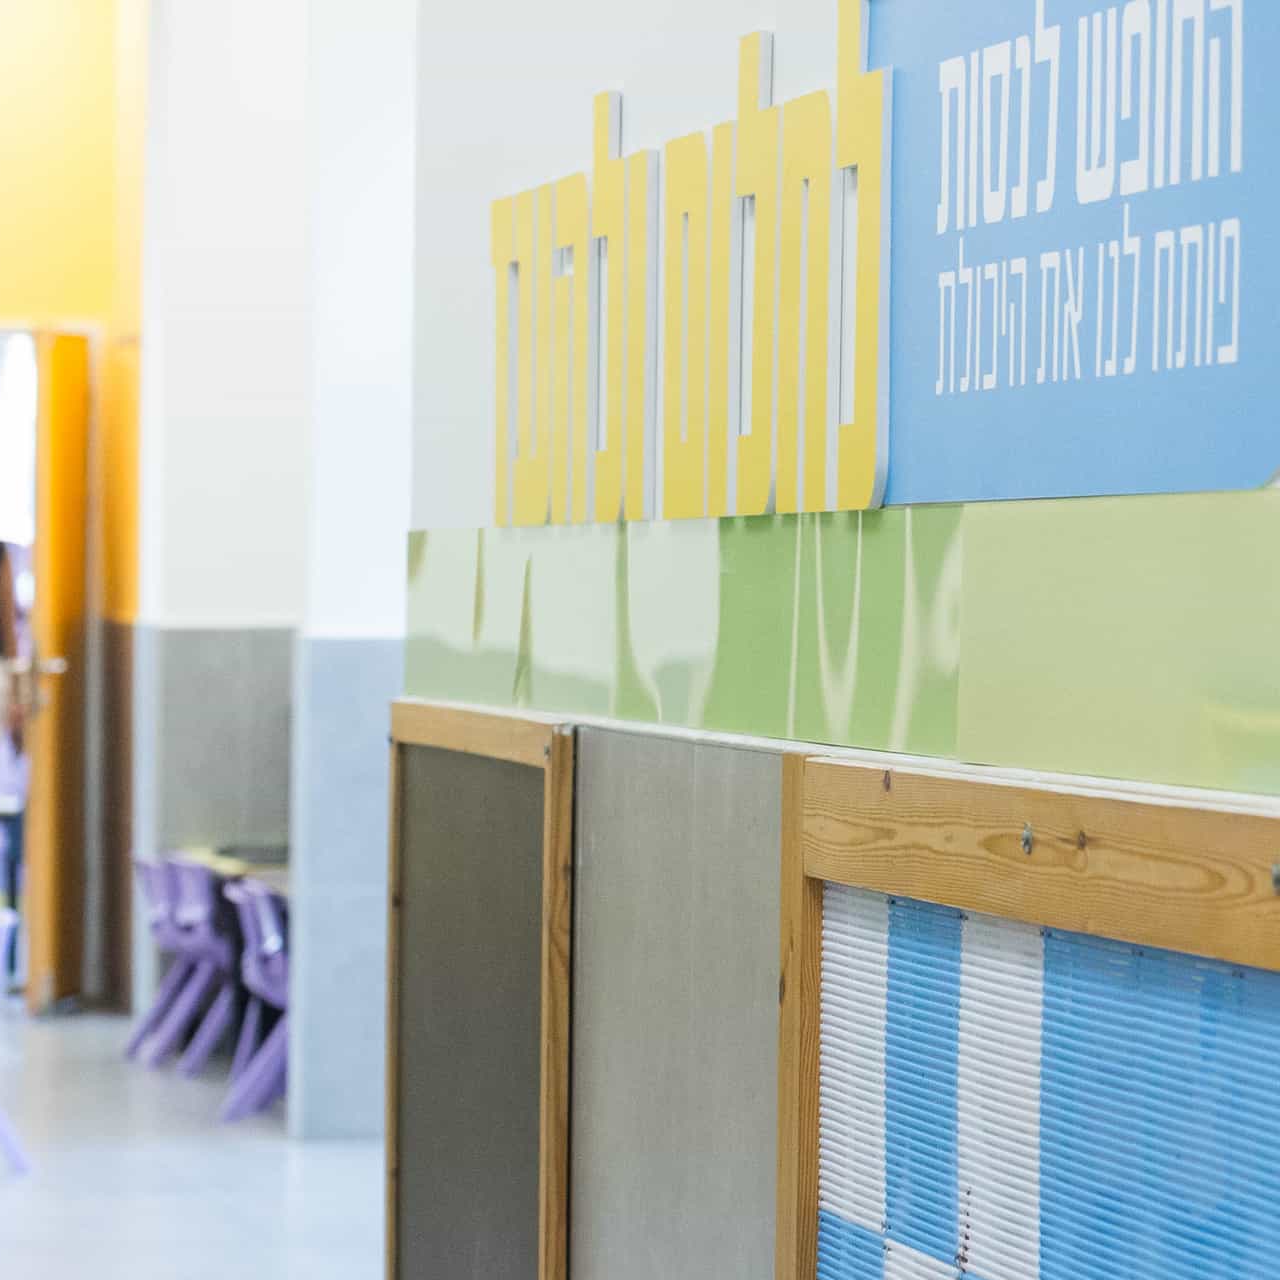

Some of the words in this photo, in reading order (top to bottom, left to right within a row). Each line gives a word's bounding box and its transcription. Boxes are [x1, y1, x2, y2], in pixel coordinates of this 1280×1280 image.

[936, 0, 1062, 236] לנסות
[1076, 0, 1243, 205] החופש
[662, 0, 885, 520] לחלום
[936, 236, 1028, 396] היכולת
[1037, 246, 1085, 385] את
[1095, 202, 1141, 378] לנו
[1151, 217, 1240, 372] פותח
